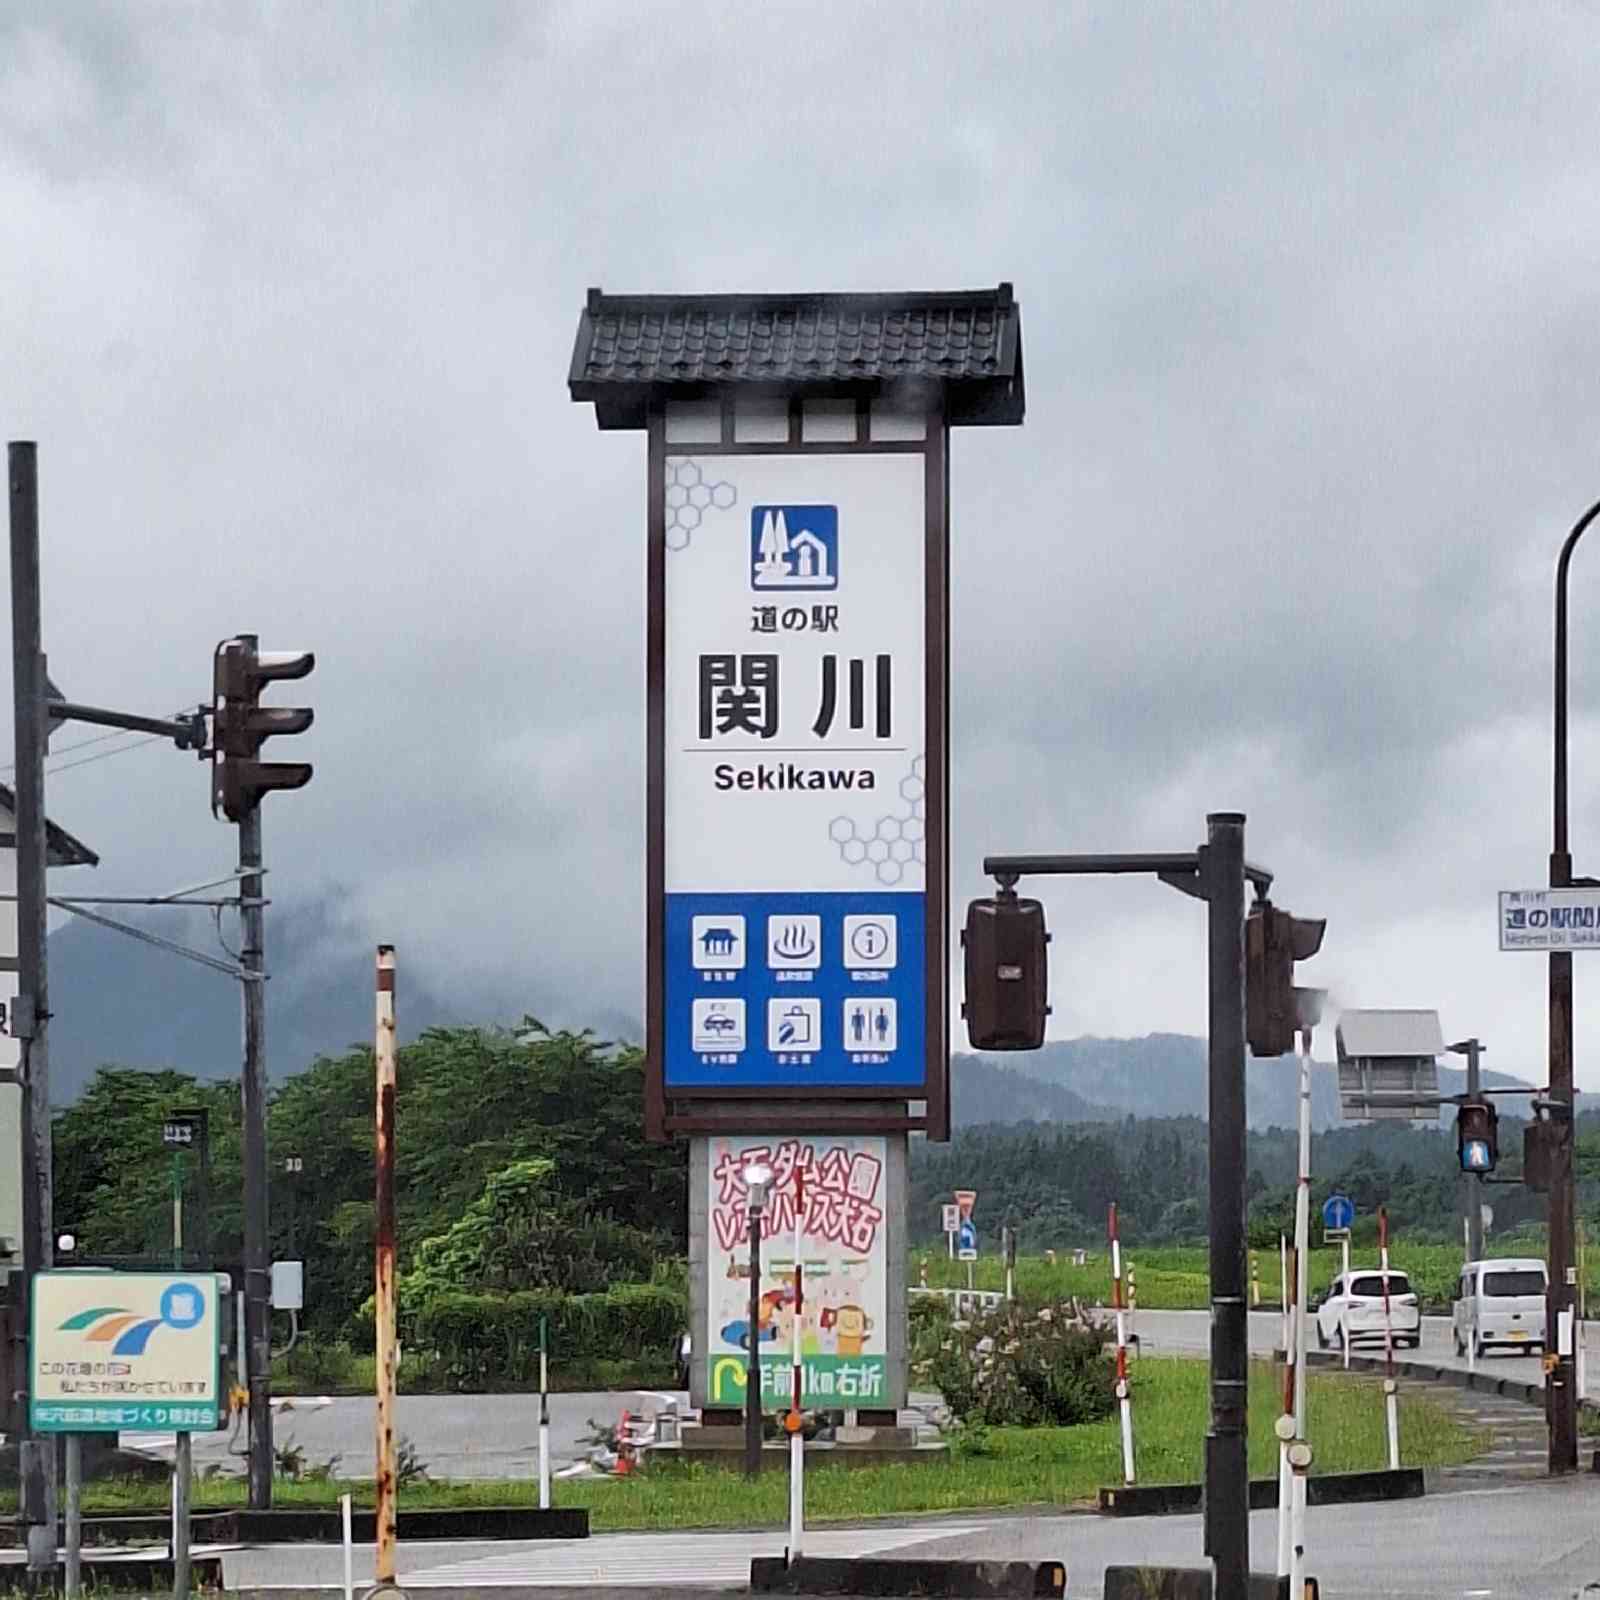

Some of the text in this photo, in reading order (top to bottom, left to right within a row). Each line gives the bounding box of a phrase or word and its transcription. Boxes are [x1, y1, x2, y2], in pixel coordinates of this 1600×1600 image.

[751, 606, 839, 633] 道の駅
[698, 654, 891, 739] 関川
[714, 764, 876, 791] Sekikawa
[1505, 907, 1600, 929] 道の駅関
